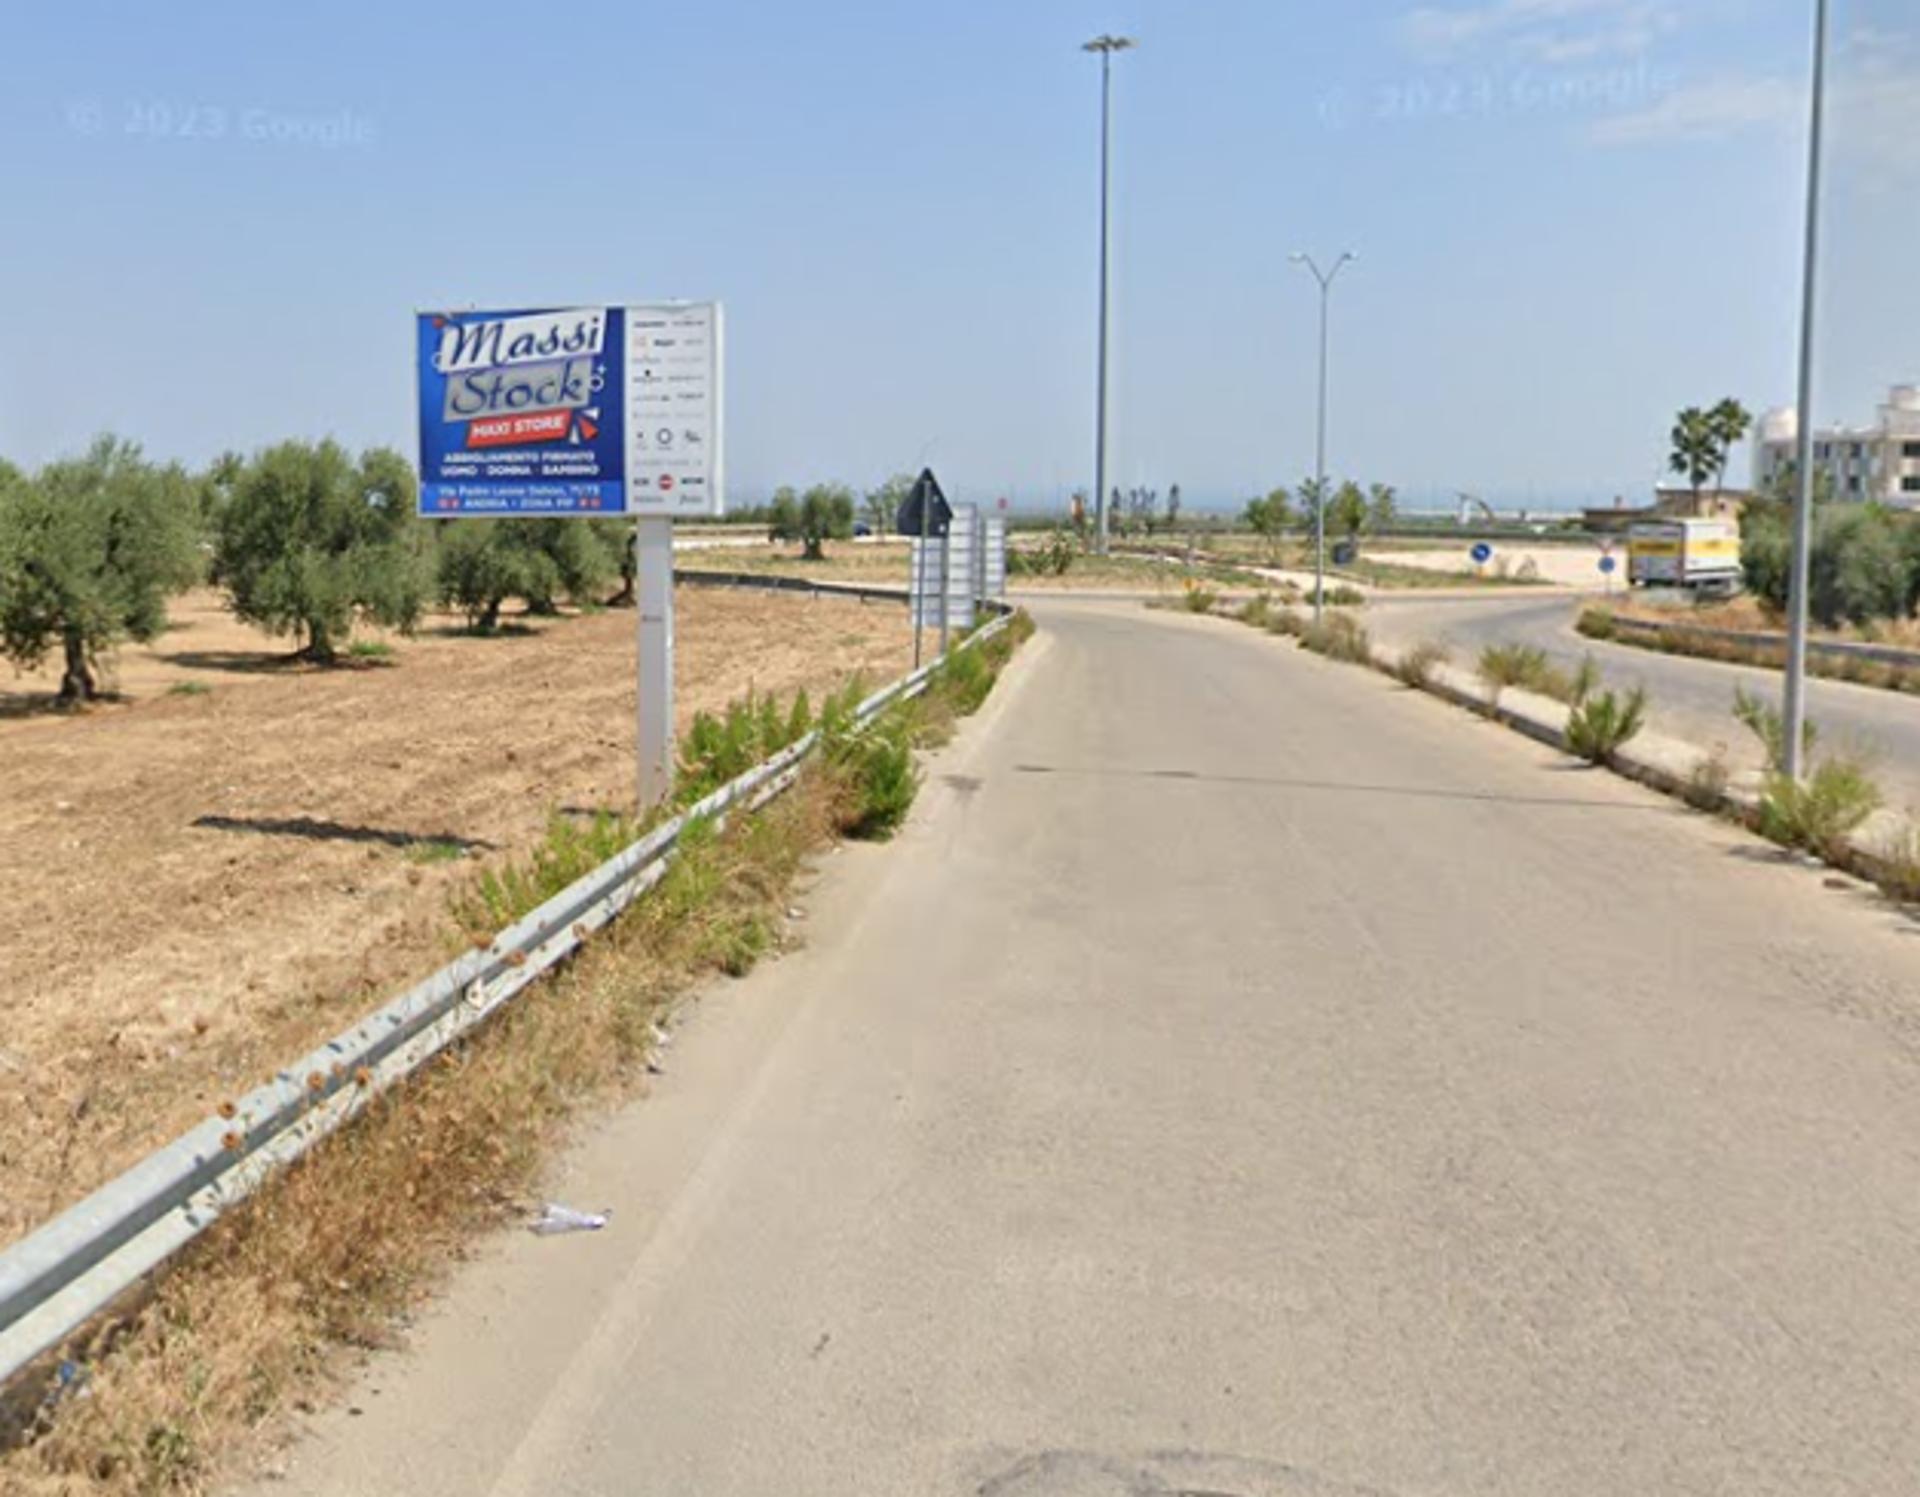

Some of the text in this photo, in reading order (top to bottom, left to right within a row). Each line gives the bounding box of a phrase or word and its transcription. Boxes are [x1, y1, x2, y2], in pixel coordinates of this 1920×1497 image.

[445, 316, 600, 368] Massi
[451, 357, 582, 414] Stock
[472, 415, 564, 438] MAXI STORE
[440, 463, 599, 476] UOMO DONNA BAMBINO
